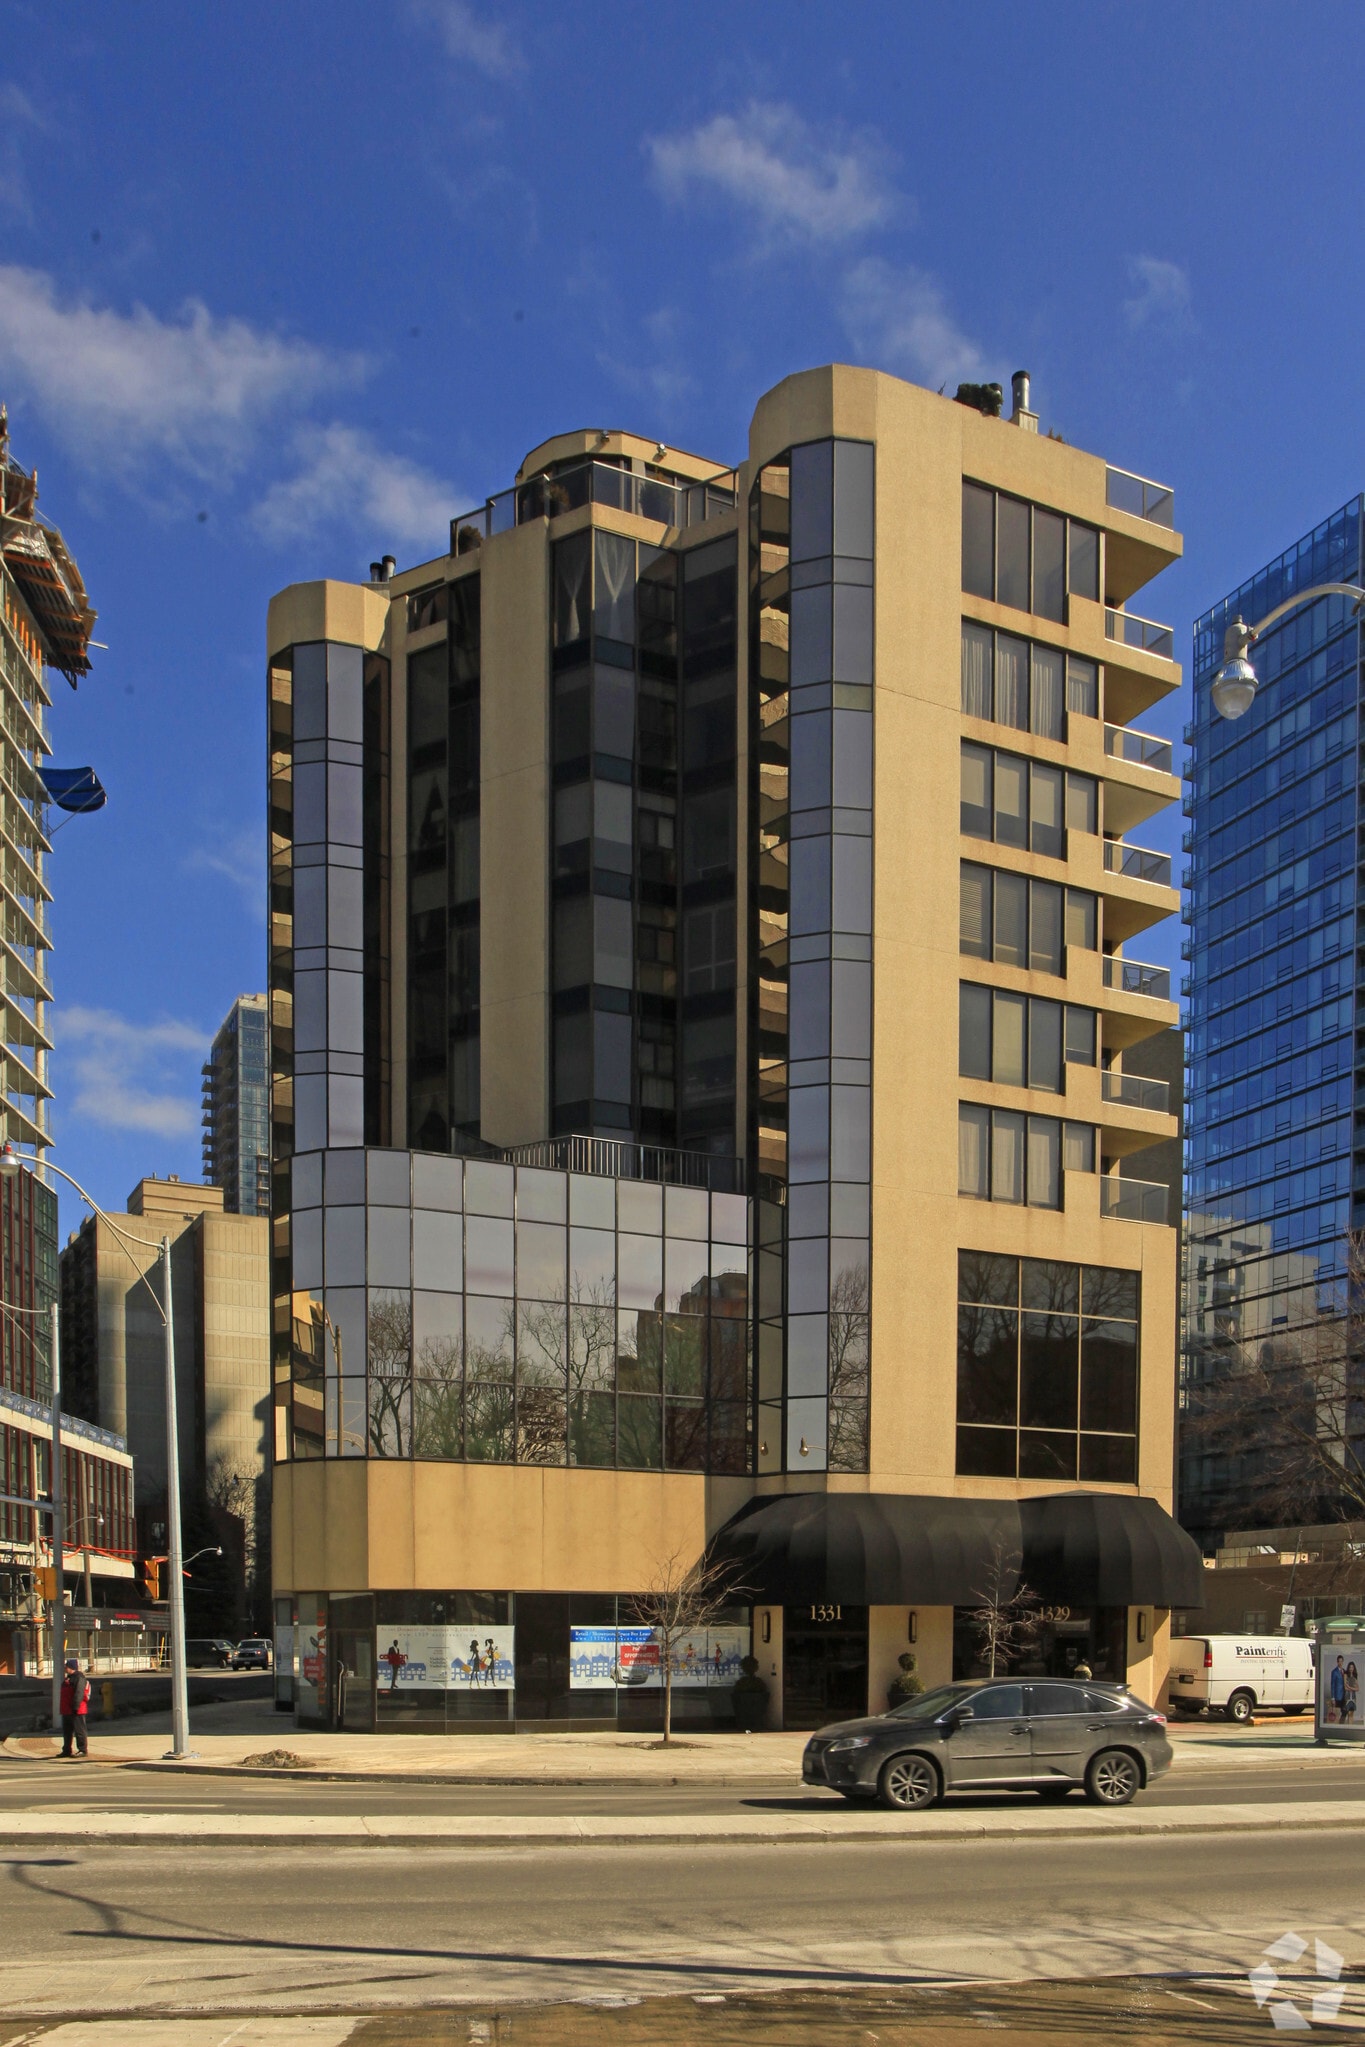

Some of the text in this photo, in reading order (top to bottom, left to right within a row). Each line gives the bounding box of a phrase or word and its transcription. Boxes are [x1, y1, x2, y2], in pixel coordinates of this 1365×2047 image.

[810, 1605, 842, 1622] 1331
[1039, 1606, 1071, 1622] 1329
[1236, 1646, 1288, 1658] Painterific
